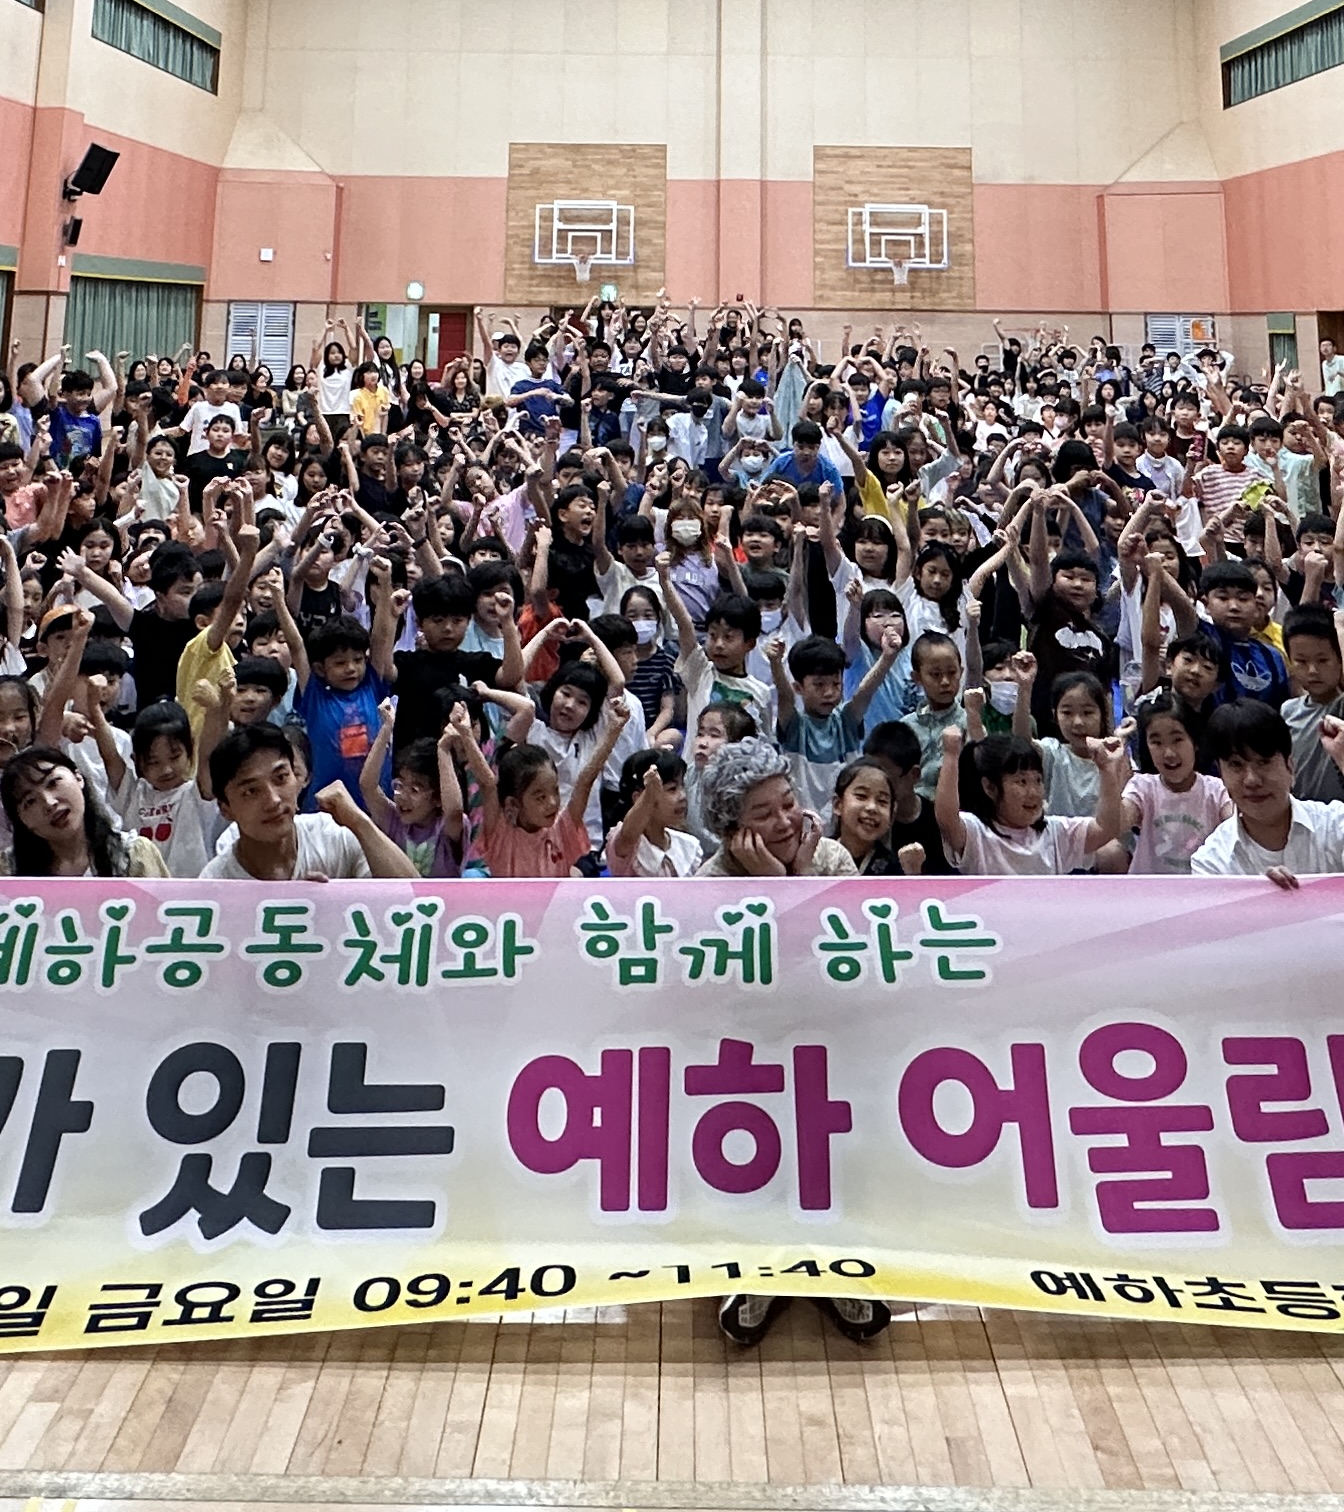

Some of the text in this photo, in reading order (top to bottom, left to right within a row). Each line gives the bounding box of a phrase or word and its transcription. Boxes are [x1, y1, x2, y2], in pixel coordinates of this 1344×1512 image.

[581, 901, 774, 986] 함께
[818, 904, 997, 984] 하는
[140, 1040, 455, 1240] 있는
[507, 1037, 852, 1214] 예하
[83, 1277, 322, 1335] 금요일
[353, 1263, 578, 1313] 09:40
